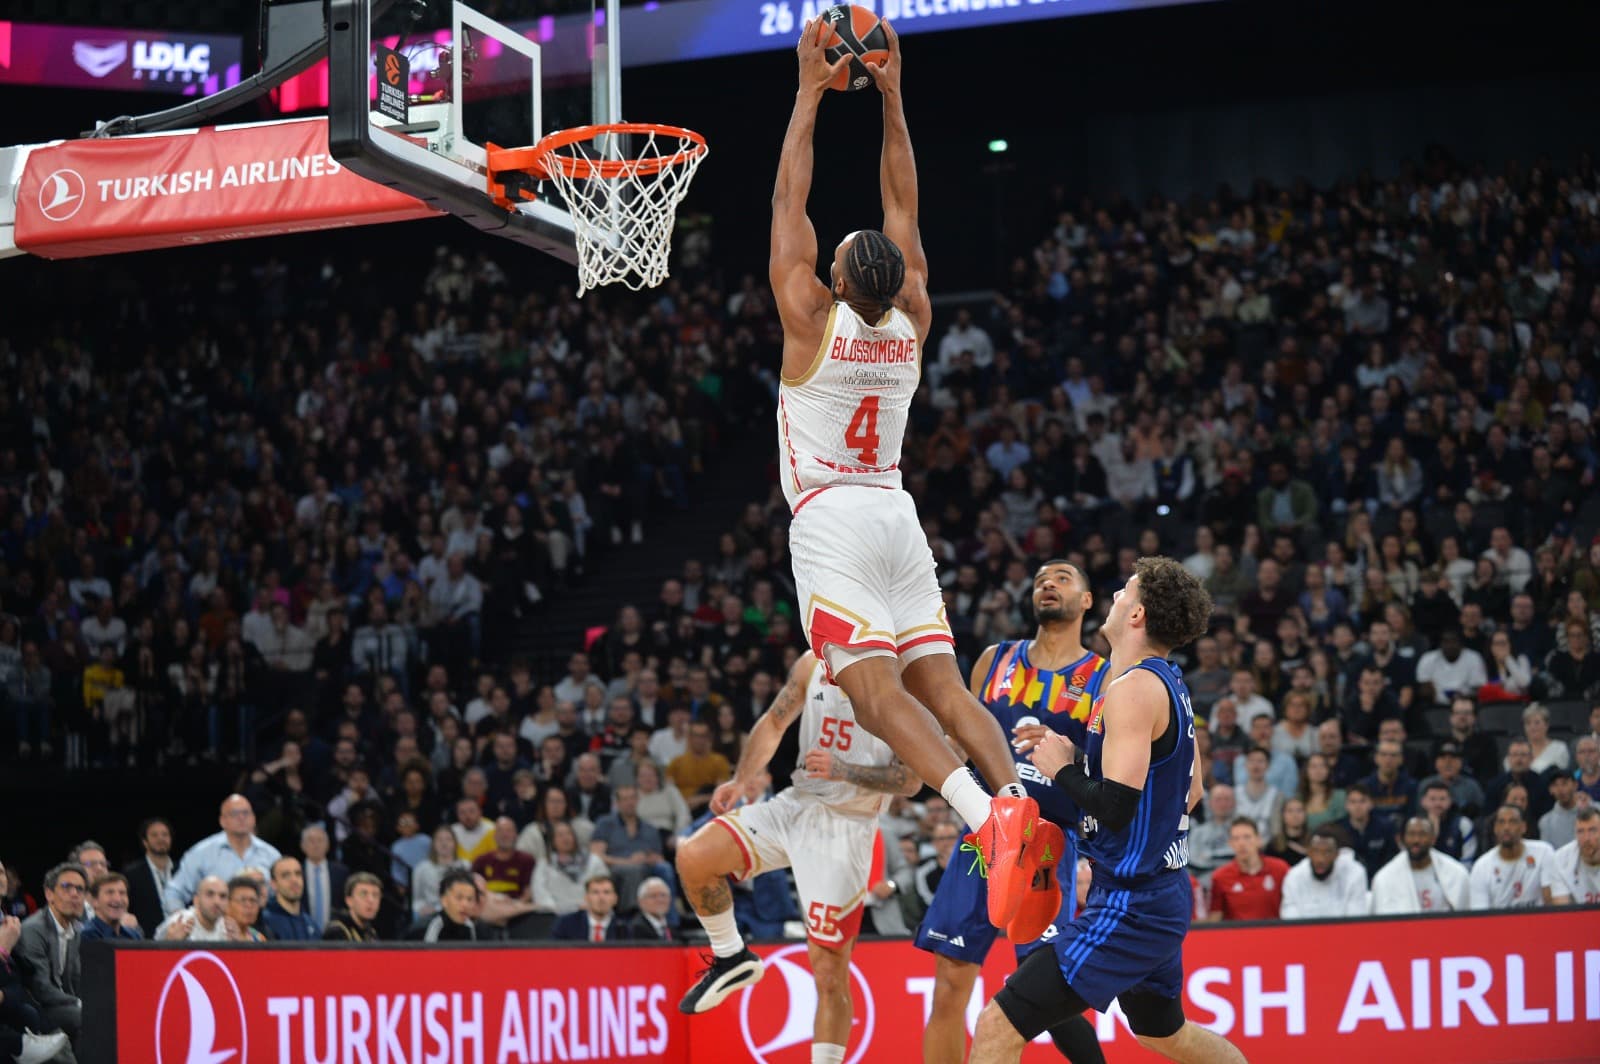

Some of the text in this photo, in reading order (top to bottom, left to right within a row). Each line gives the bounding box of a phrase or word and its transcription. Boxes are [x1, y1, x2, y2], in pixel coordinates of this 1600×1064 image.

[759, 4, 794, 36] 26
[133, 40, 210, 73] LDLC
[381, 82, 405, 101] TURKISH
[381, 92, 405, 111] AIRLINES
[97, 153, 341, 202] TURKISH AIRLINES
[844, 396, 880, 467] 4
[819, 717, 854, 751] 55
[807, 902, 843, 936] 55
[267, 984, 669, 1064] TURKISH AIRLINES
